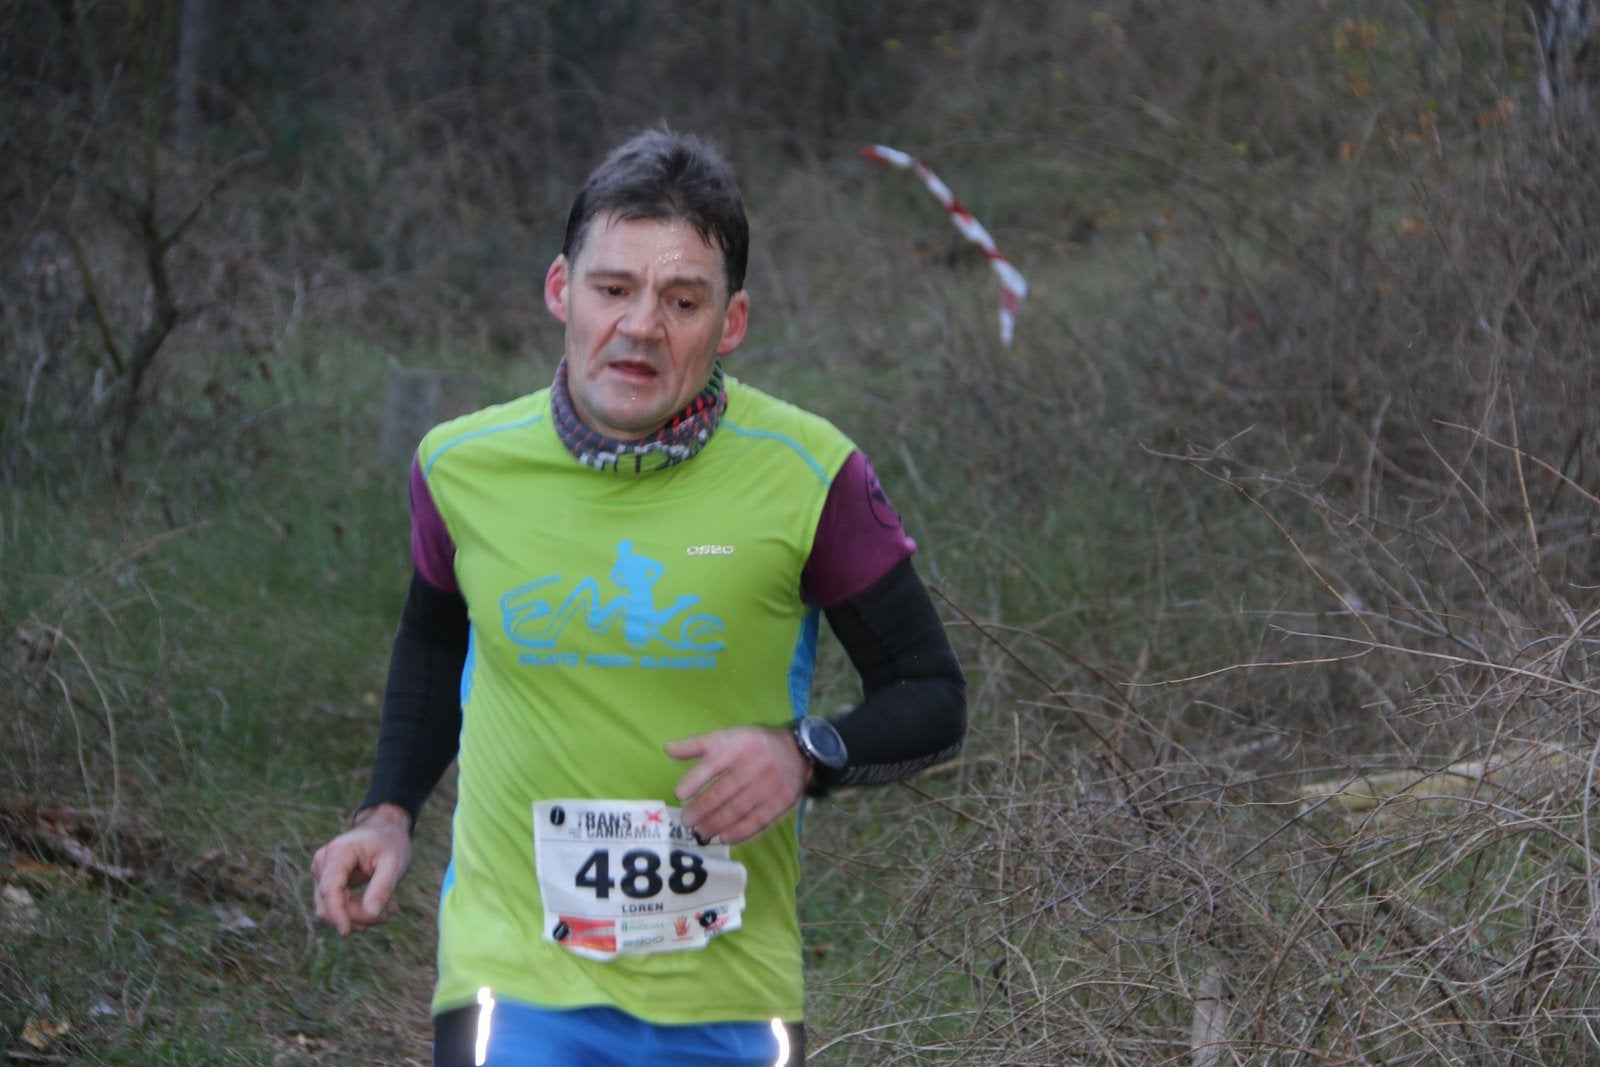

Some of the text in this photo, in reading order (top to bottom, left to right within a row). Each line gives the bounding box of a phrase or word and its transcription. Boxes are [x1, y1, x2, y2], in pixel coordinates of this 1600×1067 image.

[576, 811, 632, 830] TRANS
[575, 849, 708, 899] 488
[621, 902, 664, 914] LOREN
